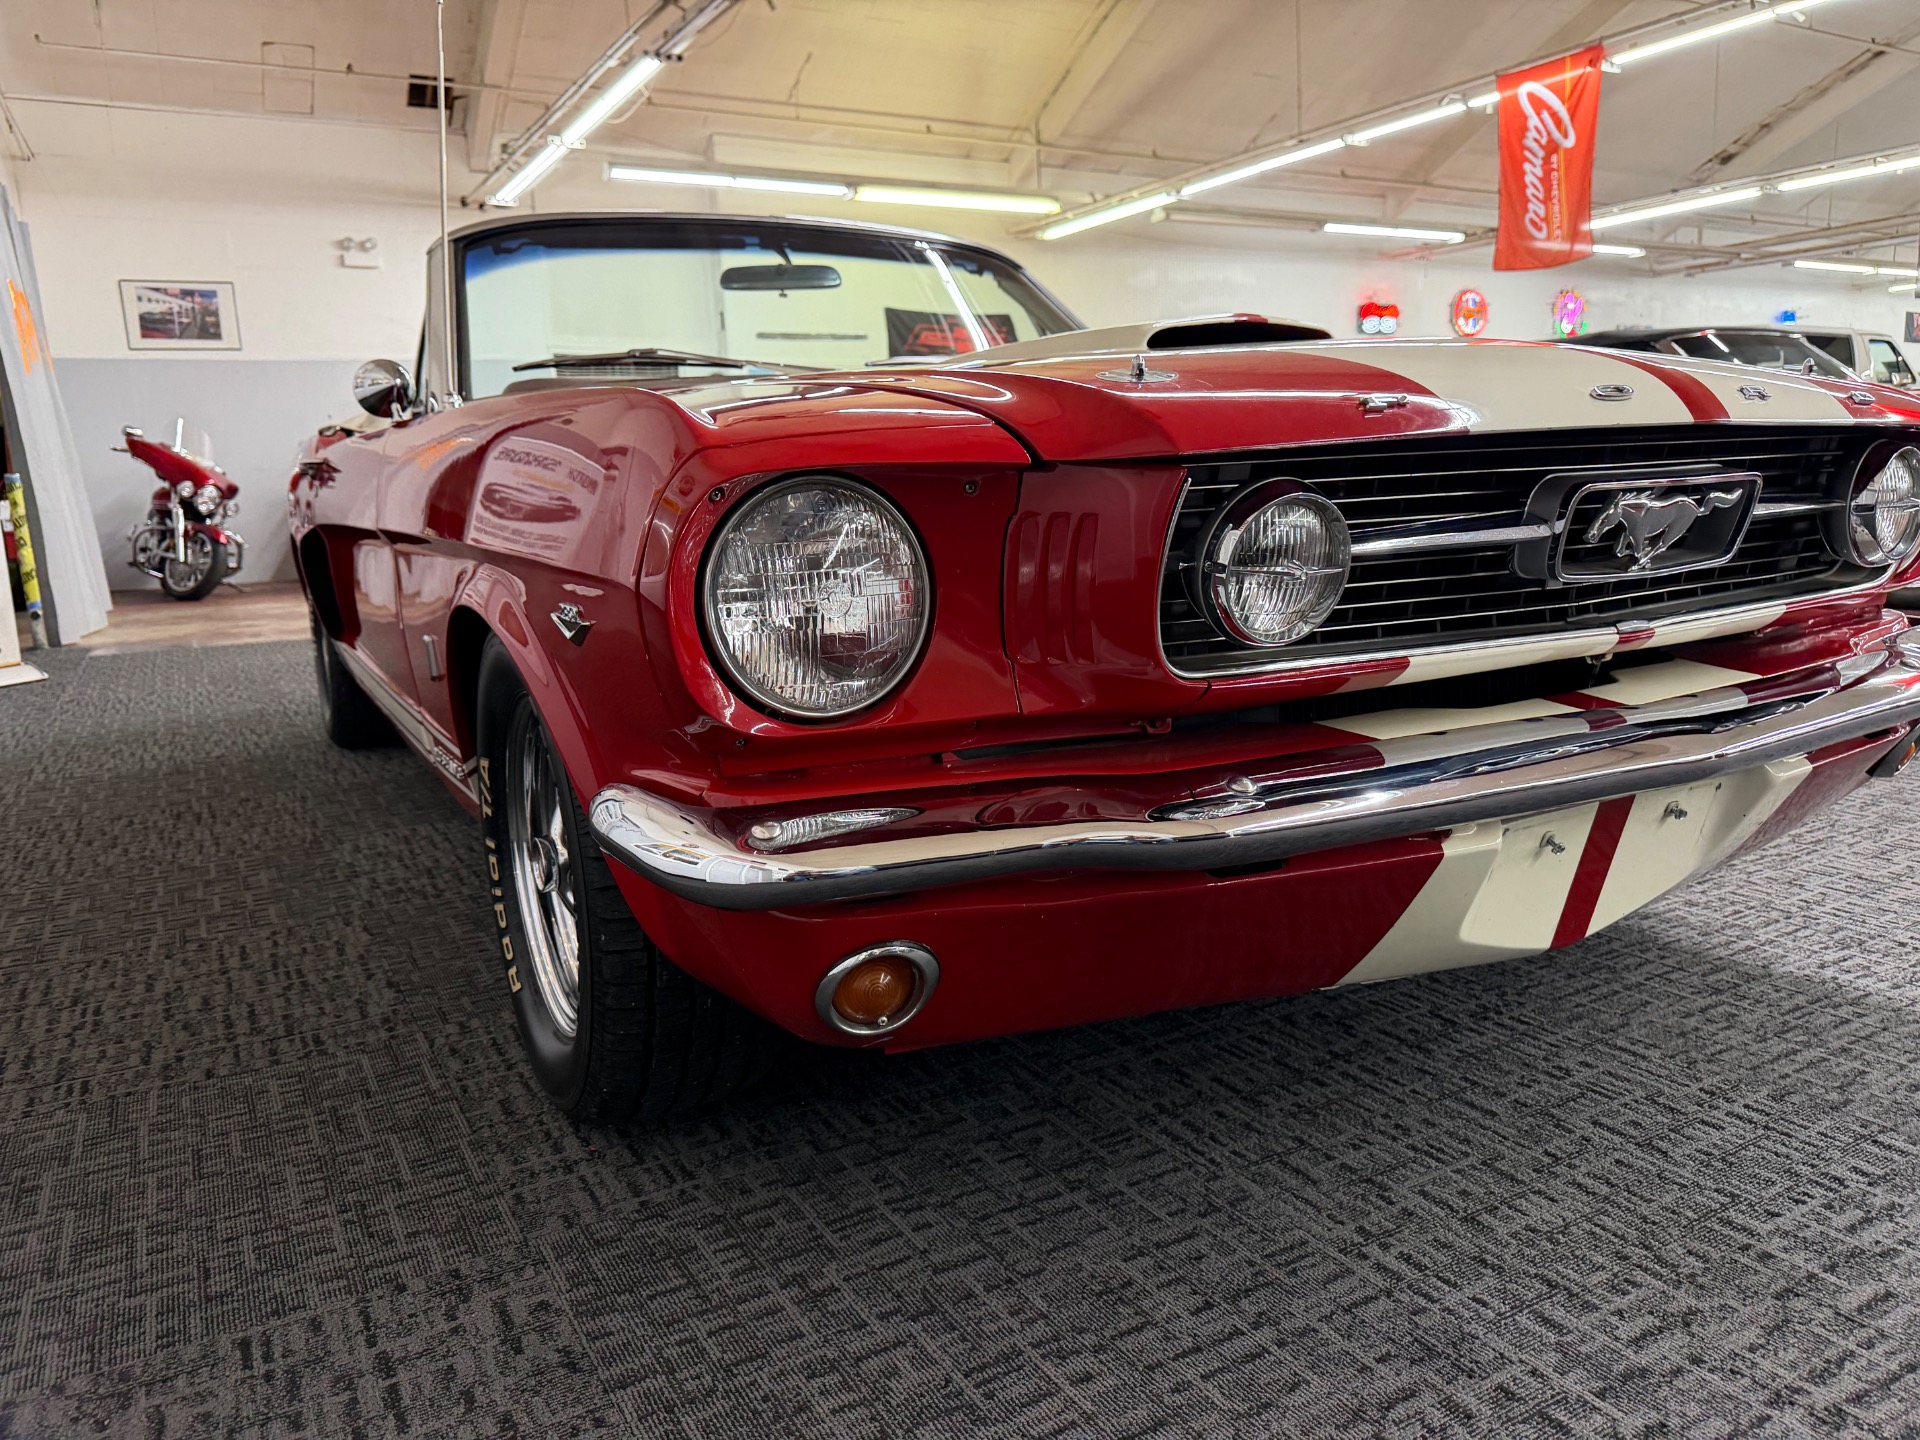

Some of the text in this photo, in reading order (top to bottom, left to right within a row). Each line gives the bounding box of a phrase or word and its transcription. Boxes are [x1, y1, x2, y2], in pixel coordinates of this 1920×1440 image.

[1517, 81, 1576, 240] Camaro
[479, 757, 523, 993] Radial T/A
